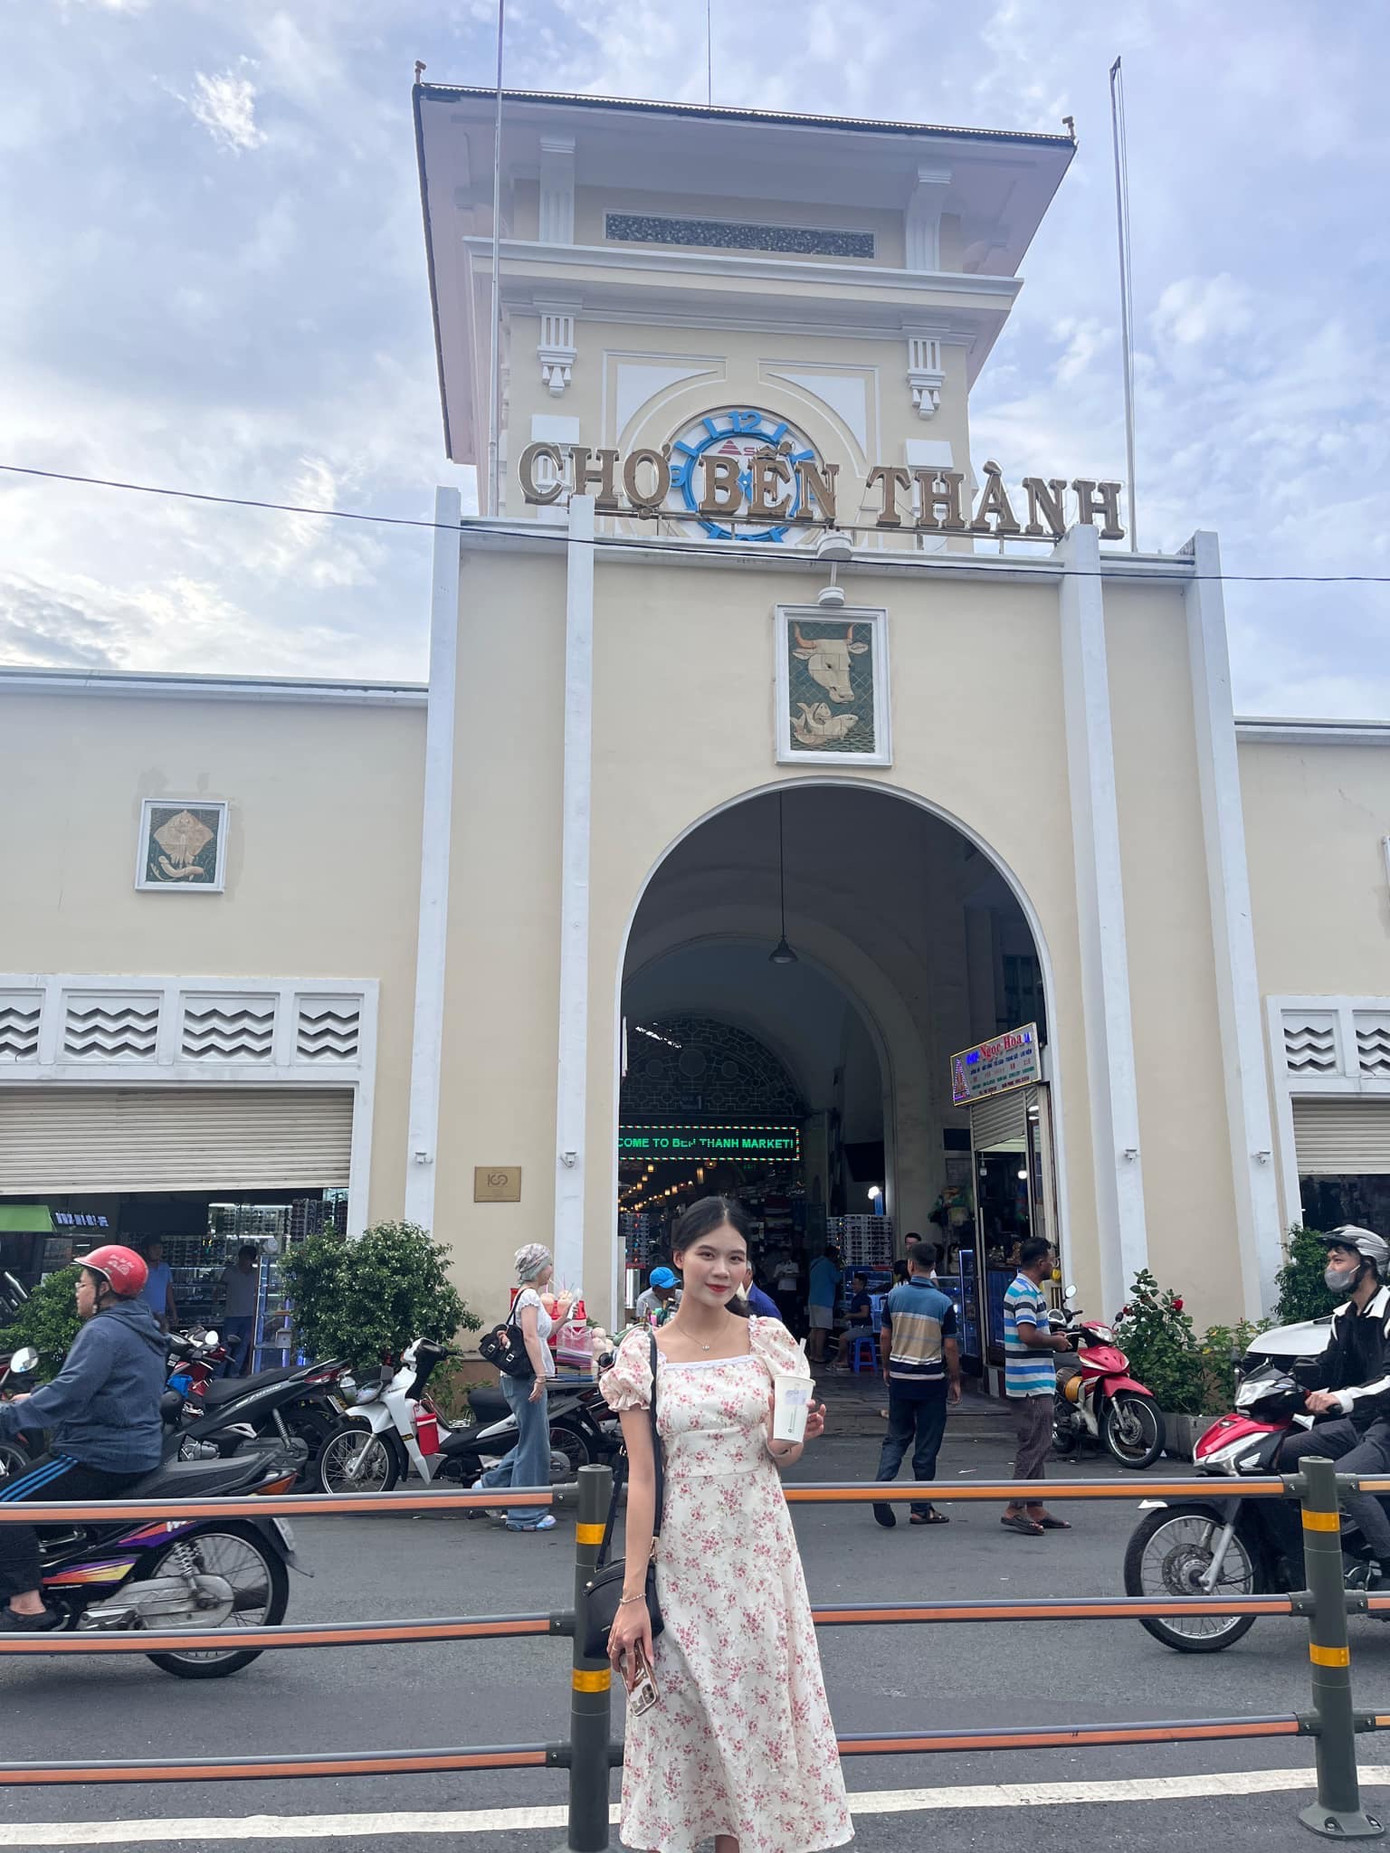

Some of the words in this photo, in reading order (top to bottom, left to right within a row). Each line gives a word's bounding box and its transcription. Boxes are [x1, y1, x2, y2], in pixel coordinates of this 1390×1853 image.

[728, 411, 763, 433] 12
[517, 441, 673, 520] CHỢ
[698, 440, 840, 520] BẾN
[865, 459, 1126, 540] THÀNH
[652, 1138, 669, 1148] TO
[699, 1138, 739, 1148] THANH
[741, 1138, 794, 1149] MARKET!
